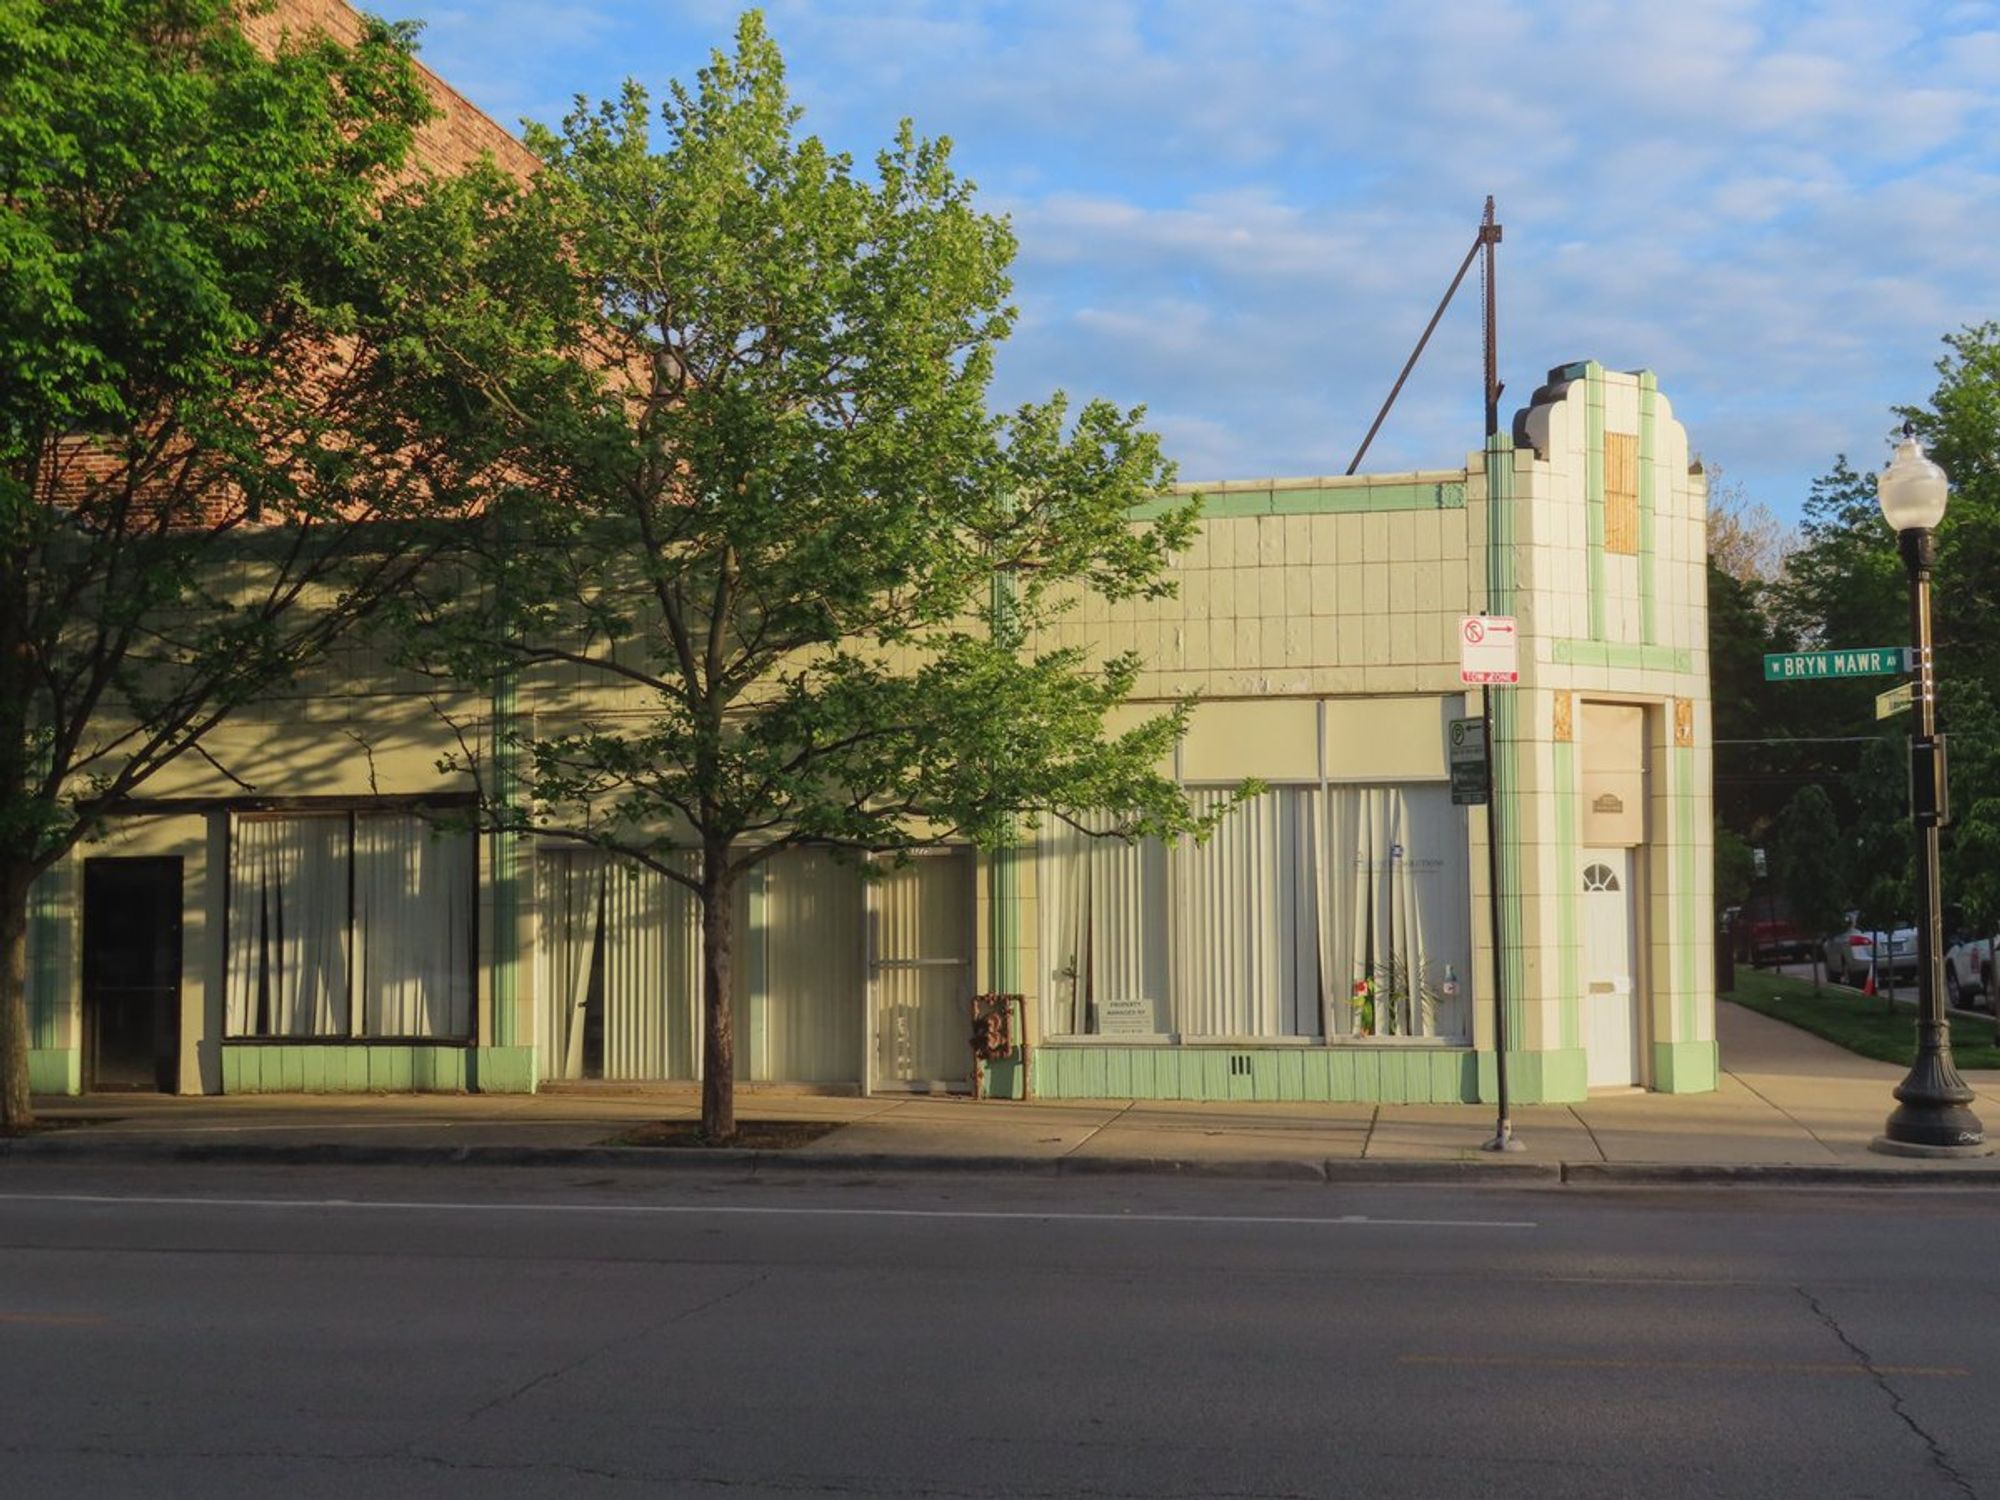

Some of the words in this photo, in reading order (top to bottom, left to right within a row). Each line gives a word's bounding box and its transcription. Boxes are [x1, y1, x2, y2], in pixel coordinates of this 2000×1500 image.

[1772, 663, 1780, 673] W
[1784, 657, 1827, 676] BRYN
[1834, 654, 1880, 673] MAWR
[1488, 672, 1512, 682] ZONE
